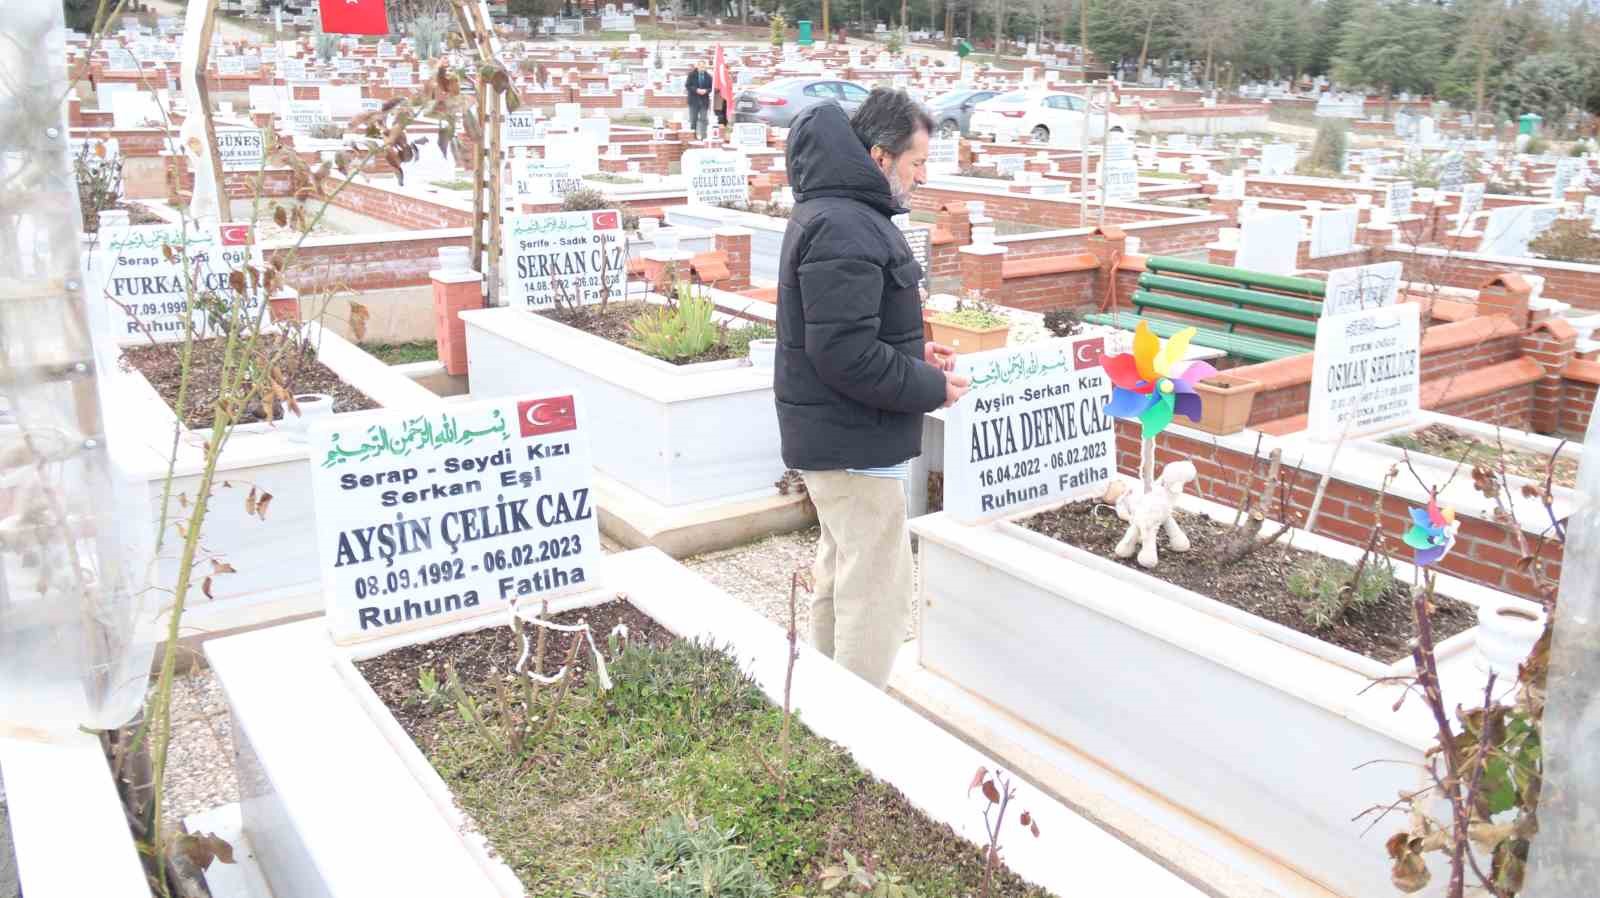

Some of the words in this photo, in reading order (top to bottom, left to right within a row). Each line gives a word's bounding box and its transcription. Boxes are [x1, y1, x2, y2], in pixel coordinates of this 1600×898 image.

[118, 256, 159, 267] Serap
[517, 250, 586, 279] SERKAN
[974, 393, 1015, 414] Ayşin
[1078, 376, 1103, 390] Kızı
[969, 415, 1018, 464] ALYA
[1019, 401, 1078, 451] DEFNE
[1080, 394, 1112, 439] CAZ
[340, 467, 418, 490] Serap
[444, 448, 513, 474] Seydi
[527, 441, 571, 460] Kızı
[381, 477, 482, 507] Serkan
[500, 465, 542, 489] Eşi
[979, 457, 1041, 488] 16.04.2022
[1051, 440, 1107, 470] 06.02.2023
[981, 482, 1049, 512] Ruhuna
[1058, 466, 1109, 492] Fatiha
[334, 512, 432, 567] AYŞİN
[440, 493, 531, 554] ÇELİK
[536, 488, 593, 528] CAZ
[355, 557, 466, 600] 08.09.1992
[484, 534, 583, 573] 06.02.2023
[358, 589, 480, 630] Ruhuna
[498, 567, 586, 599] Fatiha
